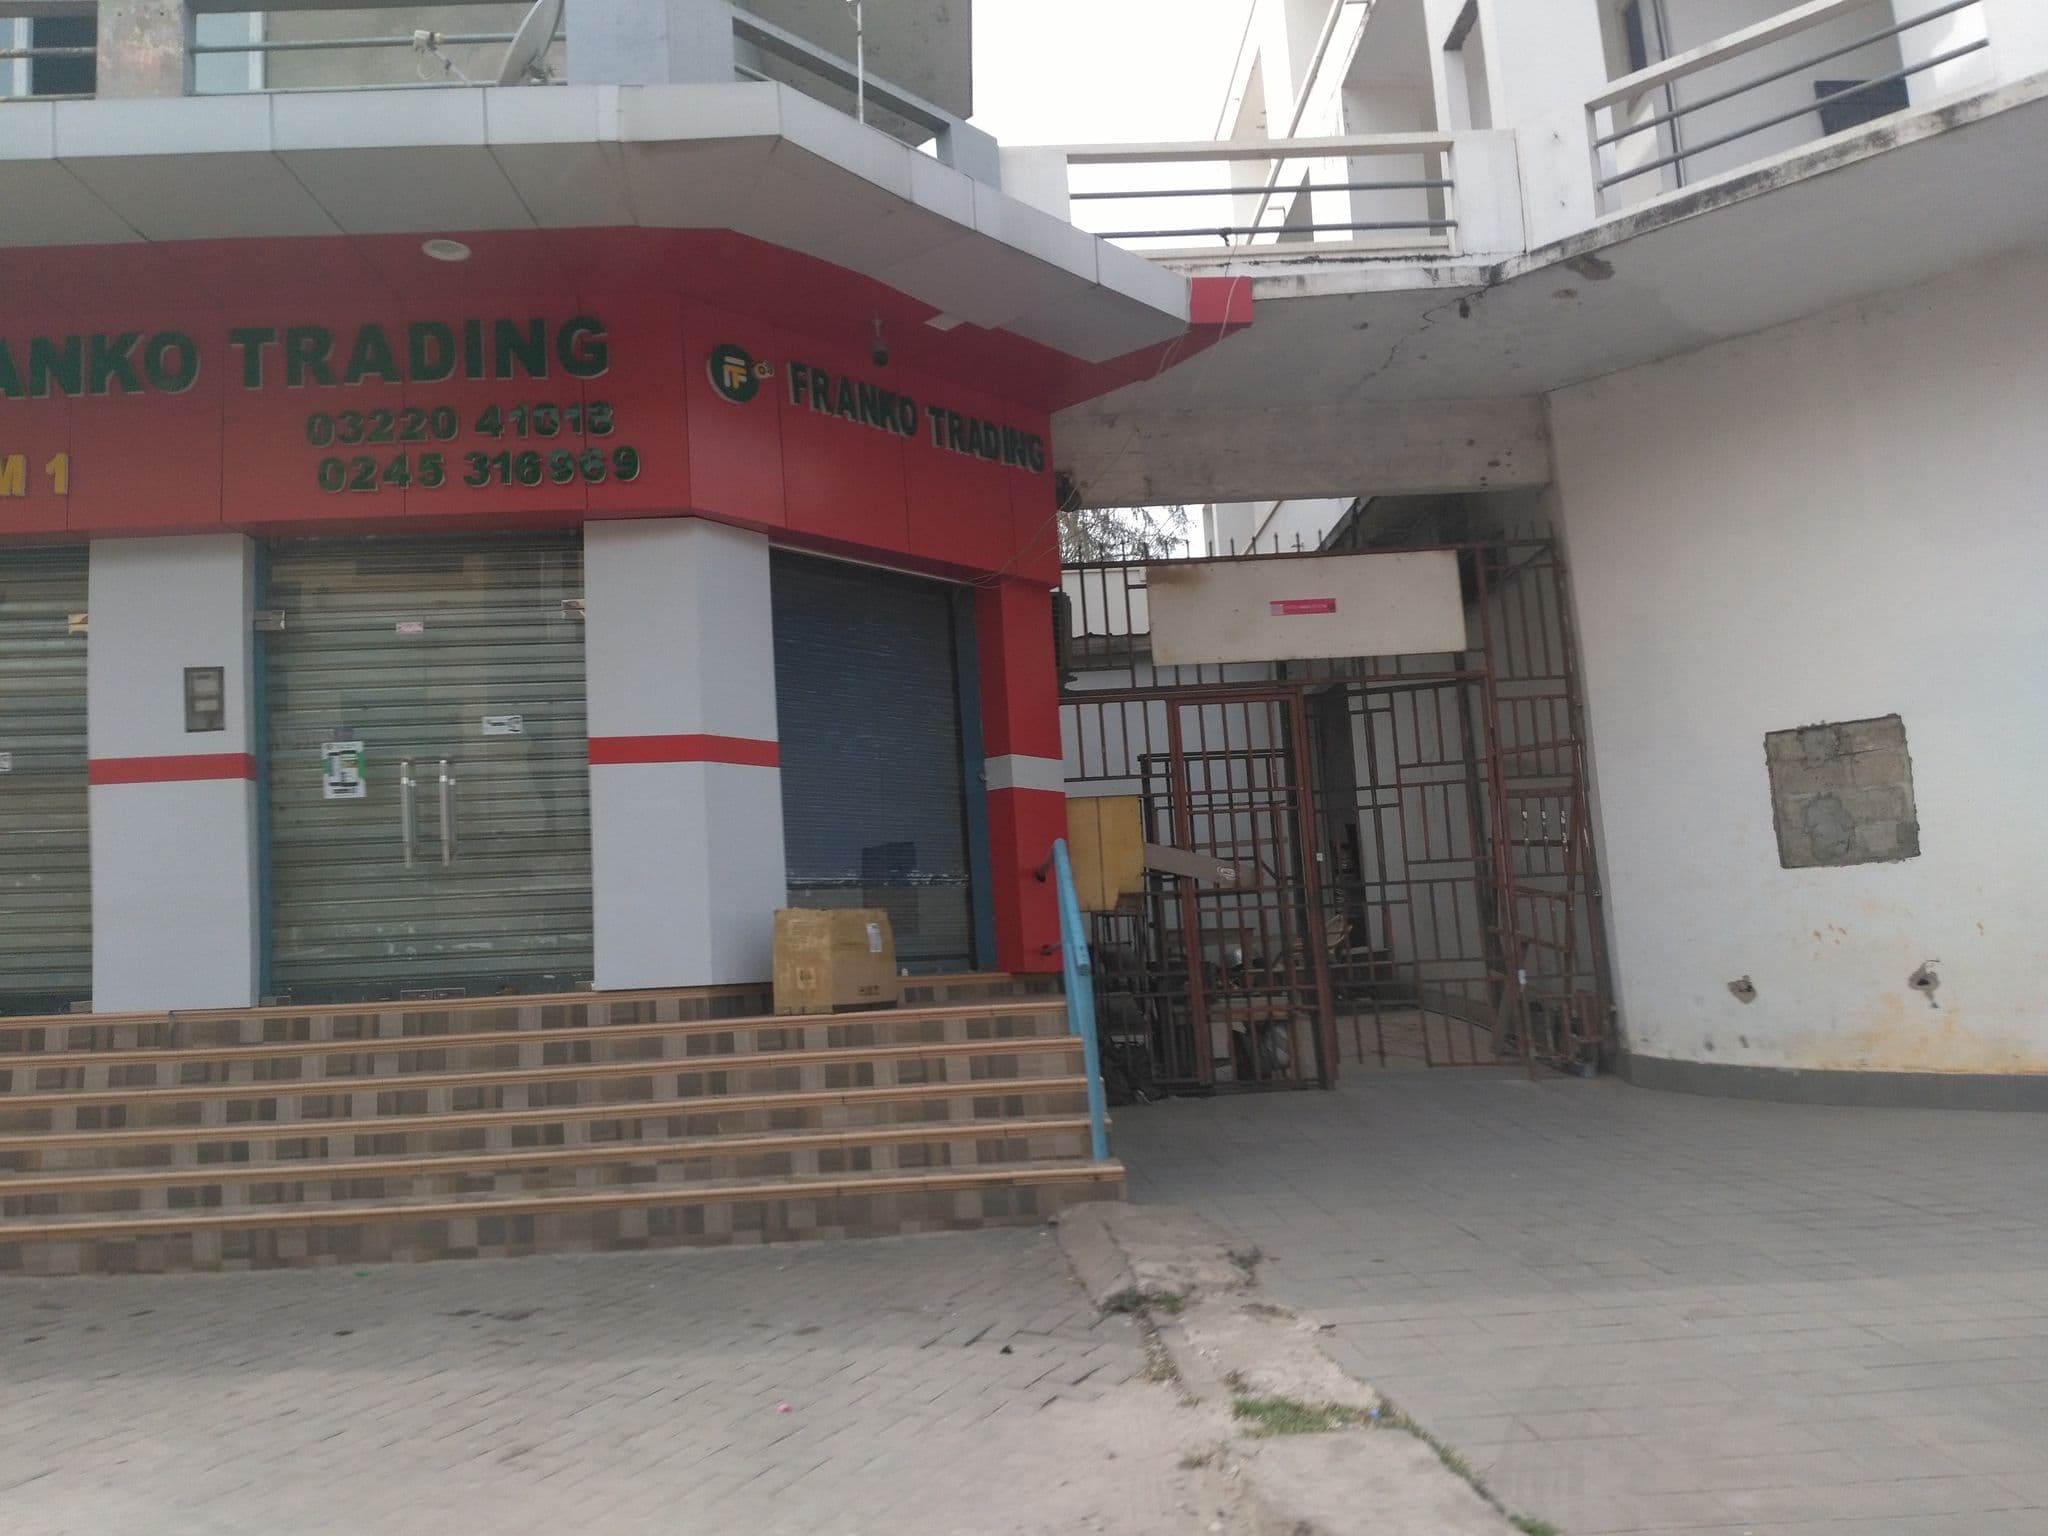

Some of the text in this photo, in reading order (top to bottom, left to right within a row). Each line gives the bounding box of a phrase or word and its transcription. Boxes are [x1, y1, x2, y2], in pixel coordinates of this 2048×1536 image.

[229, 315, 609, 388] TRADING
[307, 411, 457, 448] 03220
[787, 361, 1046, 474] FRANKO TRADING
[45, 452, 68, 495] 1
[318, 446, 640, 493] 0245 316969
